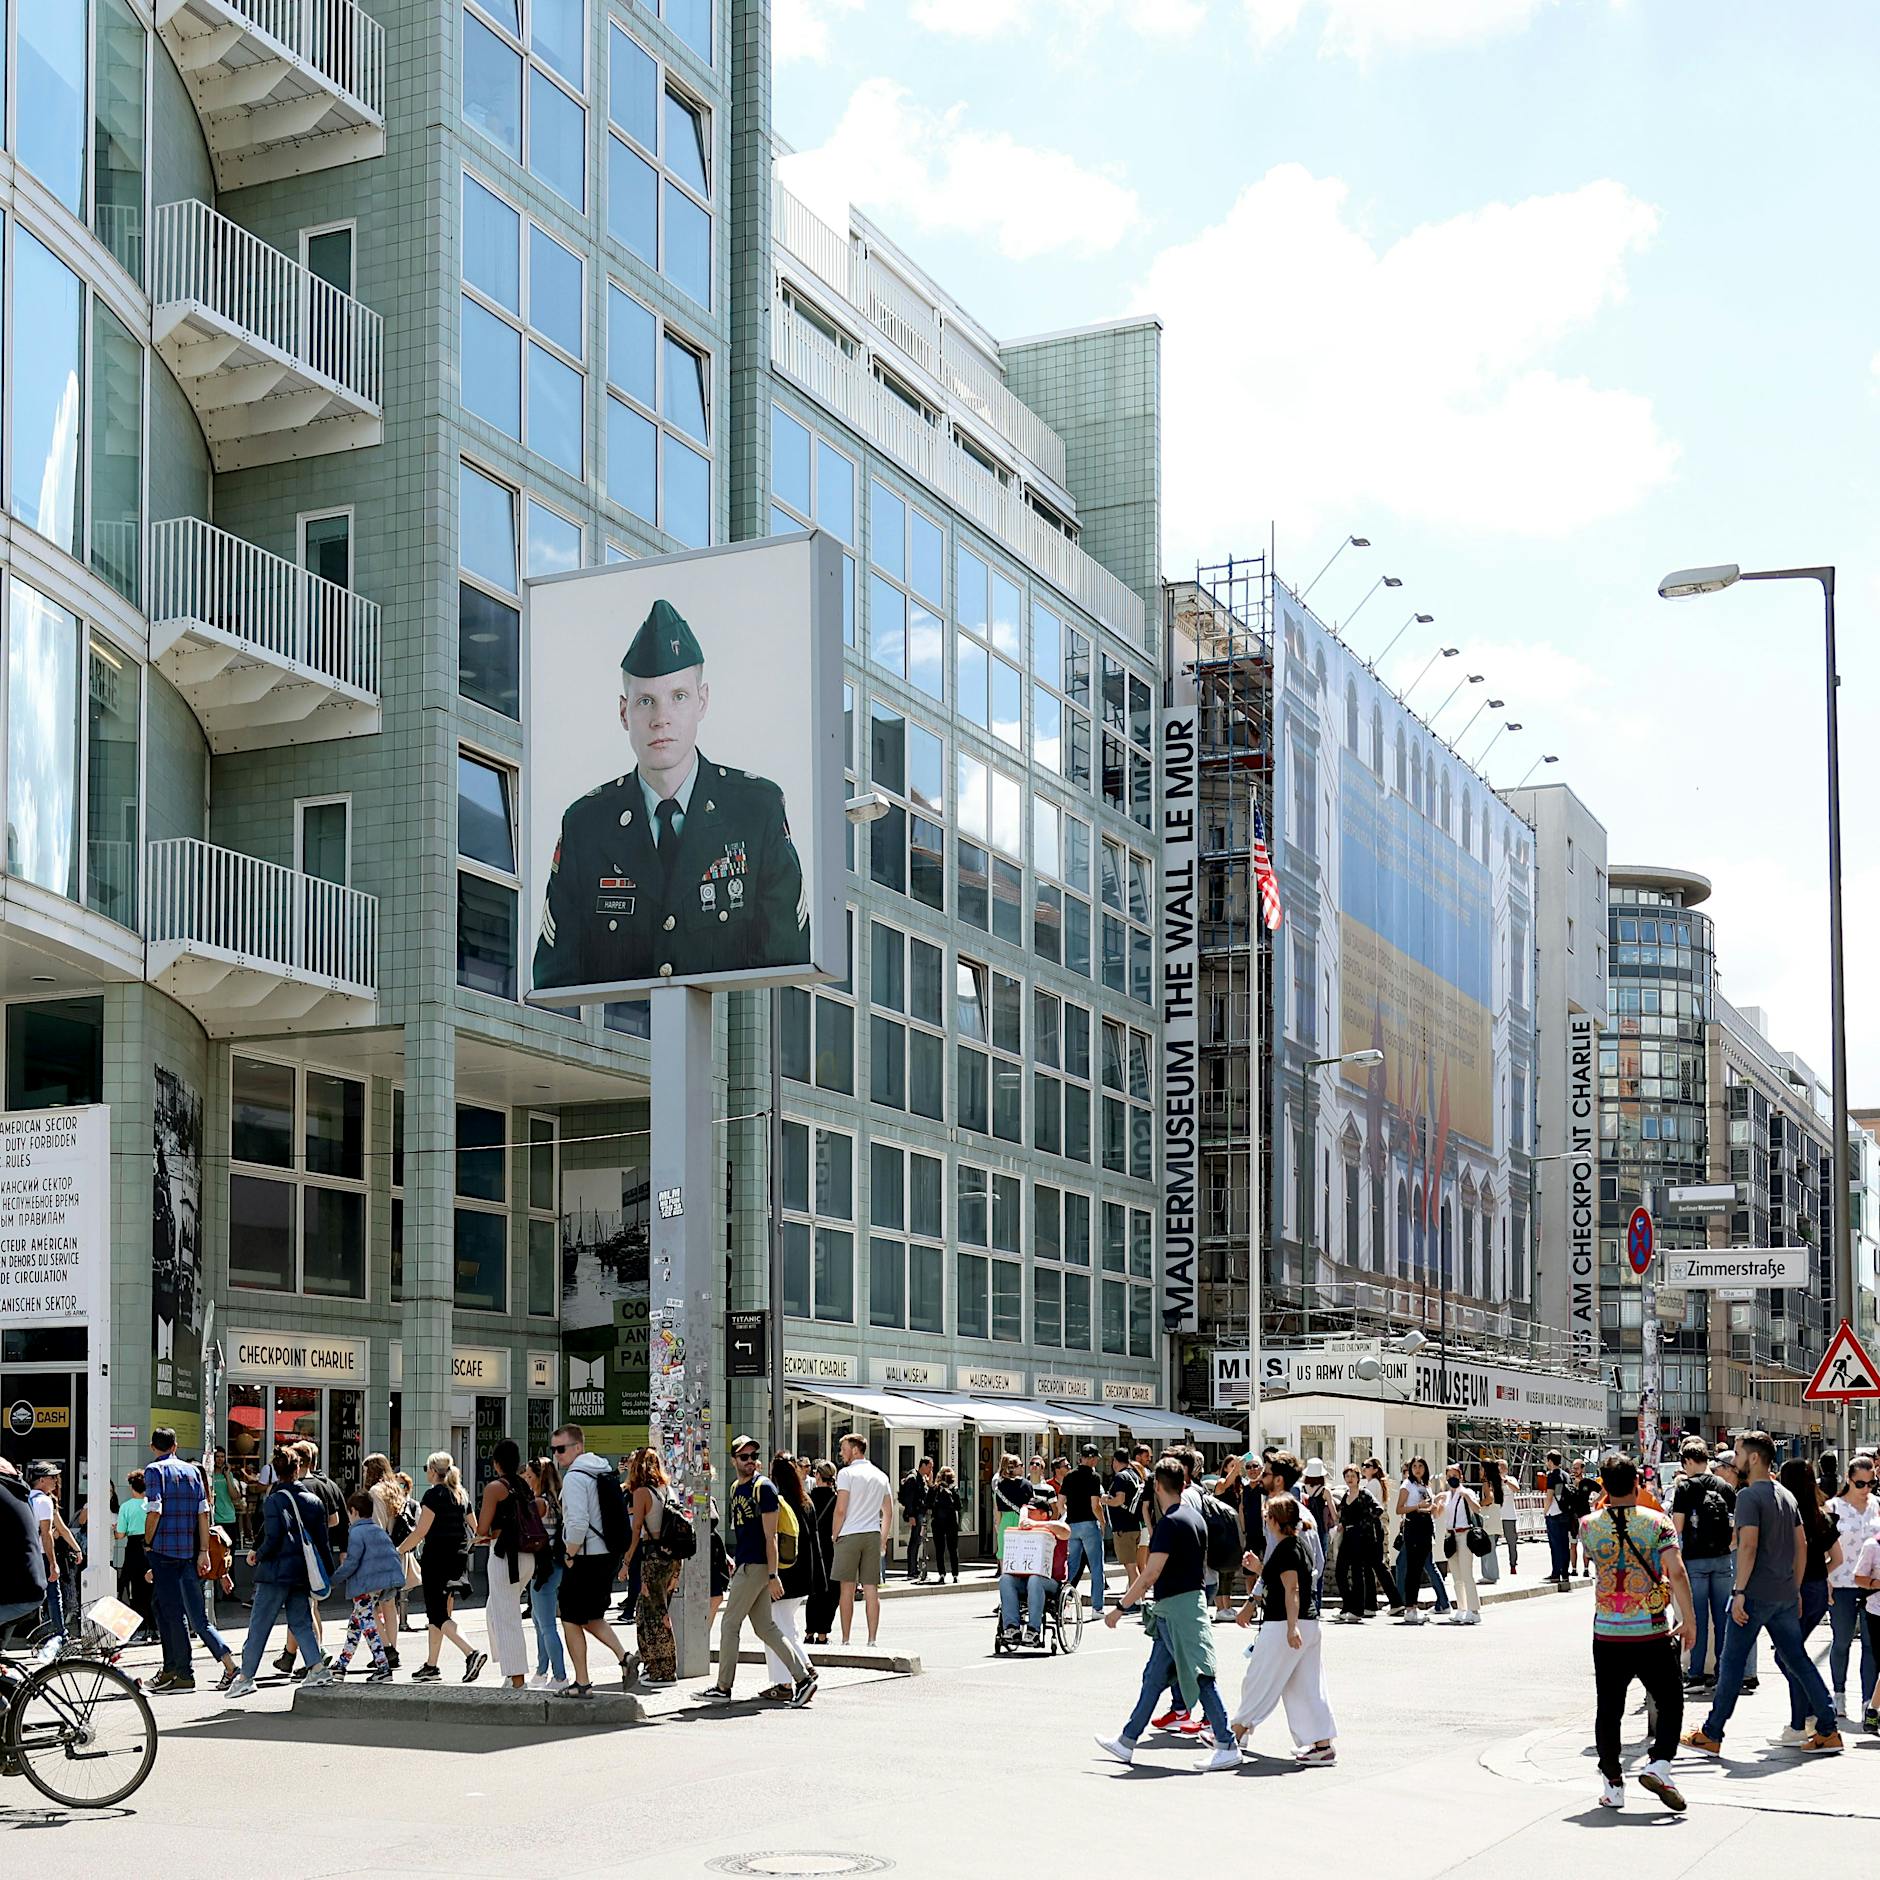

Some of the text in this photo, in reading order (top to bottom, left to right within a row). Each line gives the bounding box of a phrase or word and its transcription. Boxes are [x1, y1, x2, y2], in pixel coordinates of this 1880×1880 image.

[604, 900, 627, 910] HARPER
[1164, 718, 1195, 1319] MAUERMUSEUM THE WALL LE MUR
[1572, 1021, 1591, 1118] CHARLIE
[45, 1116, 78, 1132] SECTOR
[5, 1134, 76, 1151] DUTY FORBIDDEN
[5, 1154, 31, 1168] RULES
[42, 1177, 73, 1191] СЕКТОР
[55, 1193, 80, 1208] ВРЕМЯ
[1572, 1126, 1592, 1276] CHECKPONT
[19, 1211, 65, 1226] ПРАВИЛАМ
[1, 1239, 26, 1252] CTEUR
[9, 1254, 36, 1268] DEHORS
[38, 1253, 48, 1266] DU
[50, 1252, 80, 1266] SERVICE
[1687, 1258, 1786, 1279] Zimmerstraße
[0, 1270, 68, 1285] DE CIRCULATION
[0, 1295, 77, 1312] ANISCHEN SEKTOR
[1572, 1283, 1592, 1322] AM
[1346, 1343, 1372, 1352] CHECKPOINT
[239, 1345, 354, 1370] CHECKPOINT CHARLIE
[819, 1359, 847, 1377] CHARLIE
[885, 1366, 928, 1383] WALL MUSEUM
[1297, 1365, 1311, 1381] US
[1316, 1364, 1344, 1380] ARMY
[1038, 1378, 1087, 1396] CHECKPOINT CHARLIE
[1105, 1384, 1149, 1400] CHECKPOINT CHARLIE
[569, 1391, 605, 1405] MAUER
[1526, 1391, 1545, 1404] MUSEUM
[1564, 1395, 1588, 1409] CHECKPOINT
[1588, 1399, 1603, 1412] CHARLIE
[37, 1412, 66, 1423] CASH
[569, 1404, 605, 1416] MUSEUM
